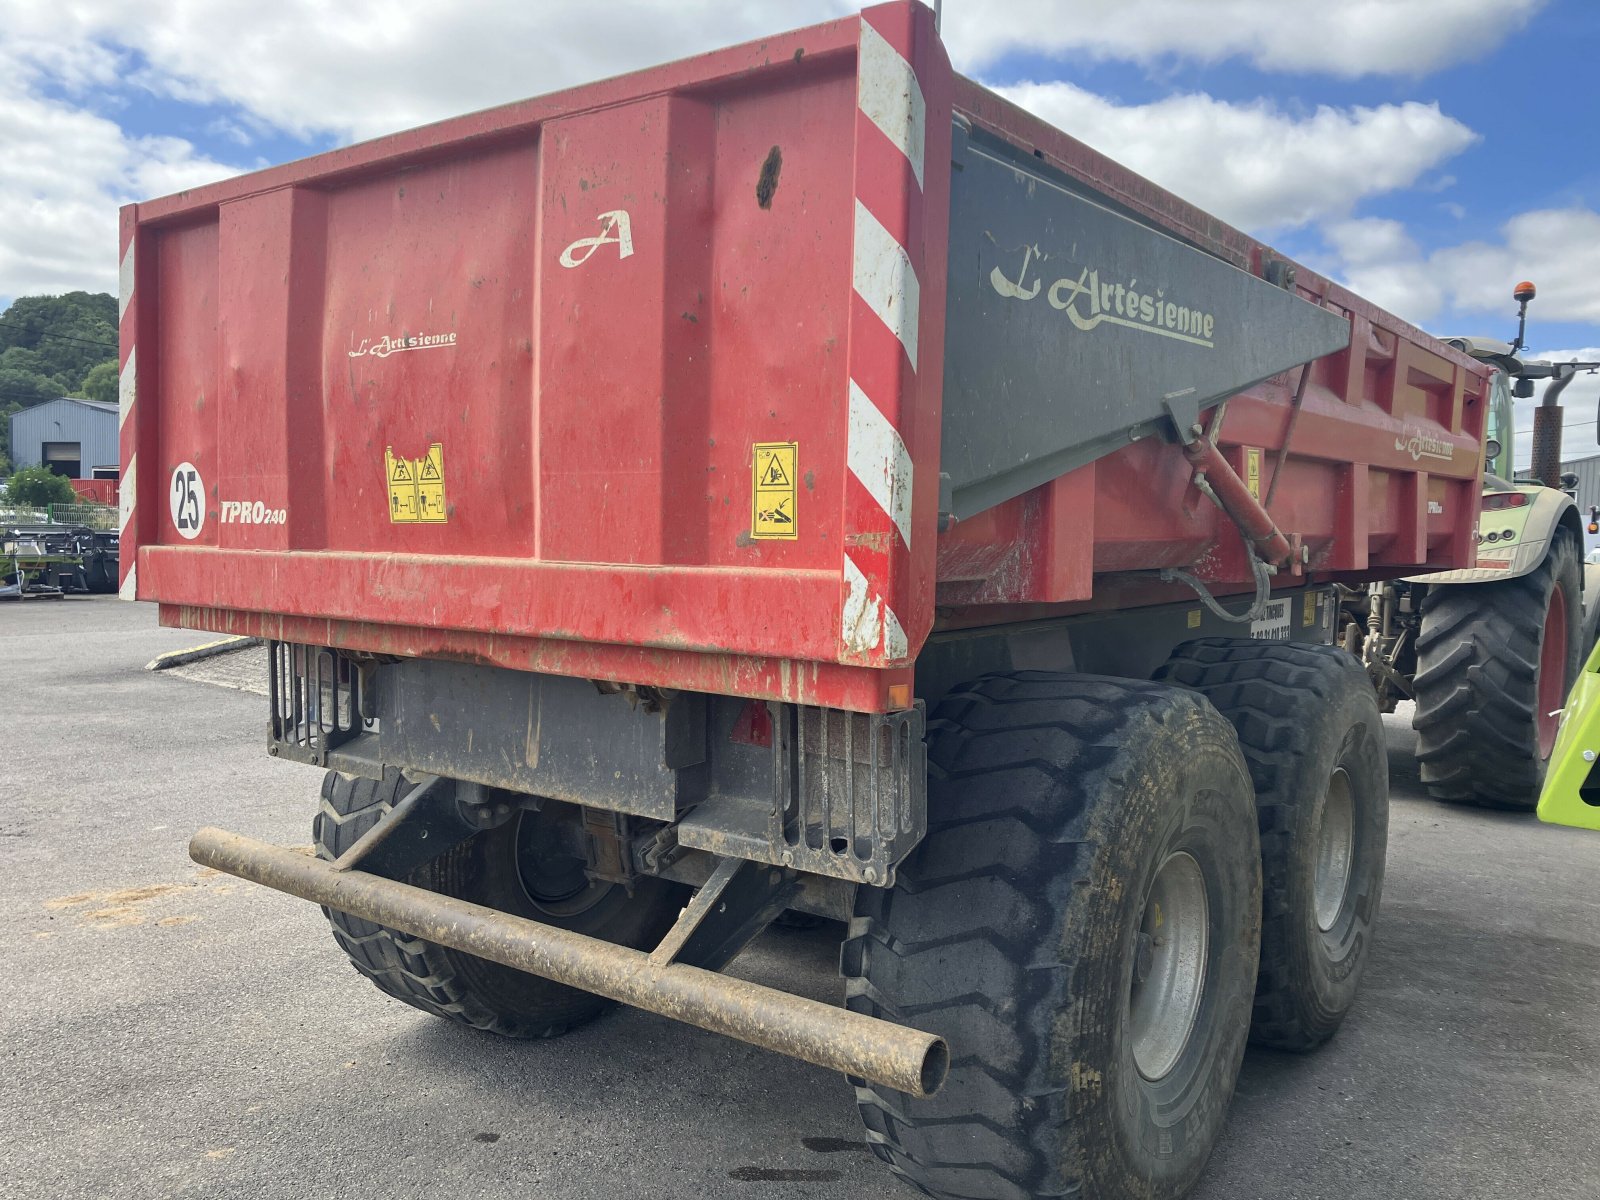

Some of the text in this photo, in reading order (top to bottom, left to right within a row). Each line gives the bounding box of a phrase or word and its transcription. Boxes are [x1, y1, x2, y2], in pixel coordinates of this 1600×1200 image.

[559, 209, 634, 268] A
[990, 243, 1214, 342] L' Artésienne
[175, 470, 199, 530] 25
[221, 500, 287, 525] TPRO240
